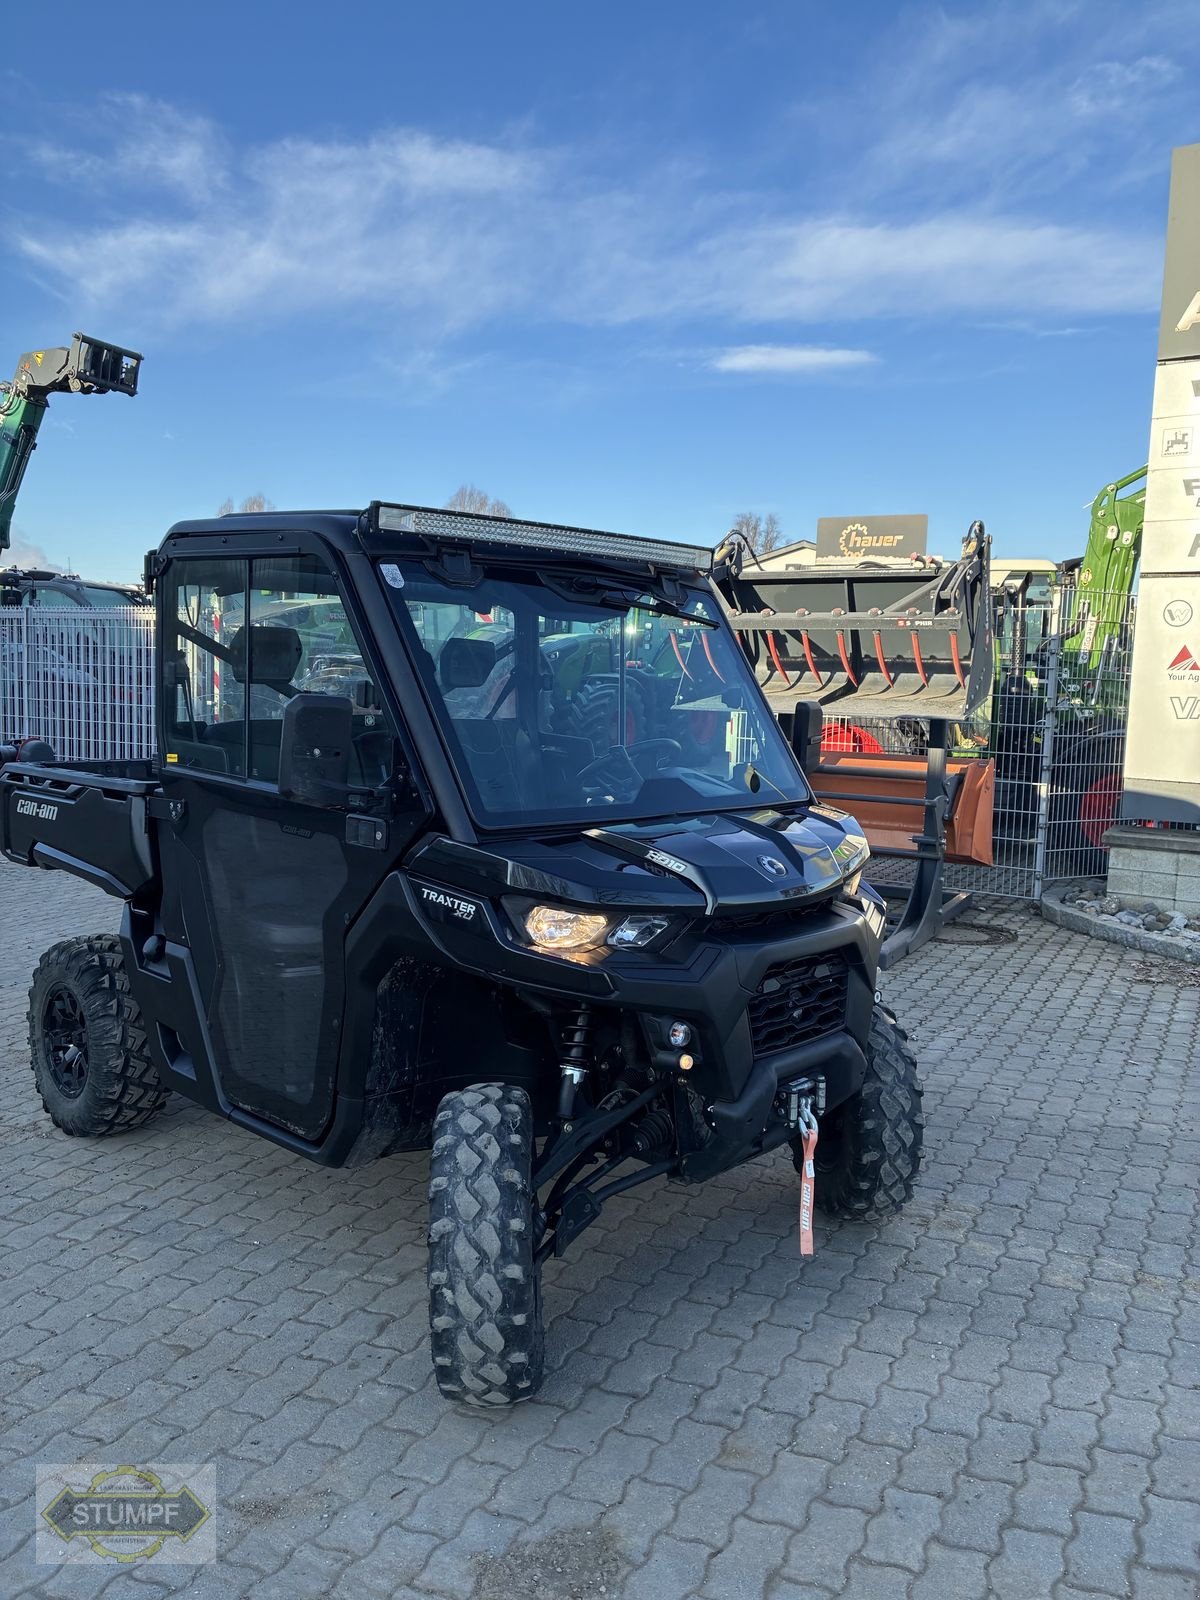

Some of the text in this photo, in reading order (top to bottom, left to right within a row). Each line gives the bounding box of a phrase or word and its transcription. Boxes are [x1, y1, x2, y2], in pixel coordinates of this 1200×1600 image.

[848, 531, 904, 548] hauer
[1168, 673, 1186, 681] Your
[16, 799, 58, 821] can-am
[421, 888, 476, 915] TRAXTER
